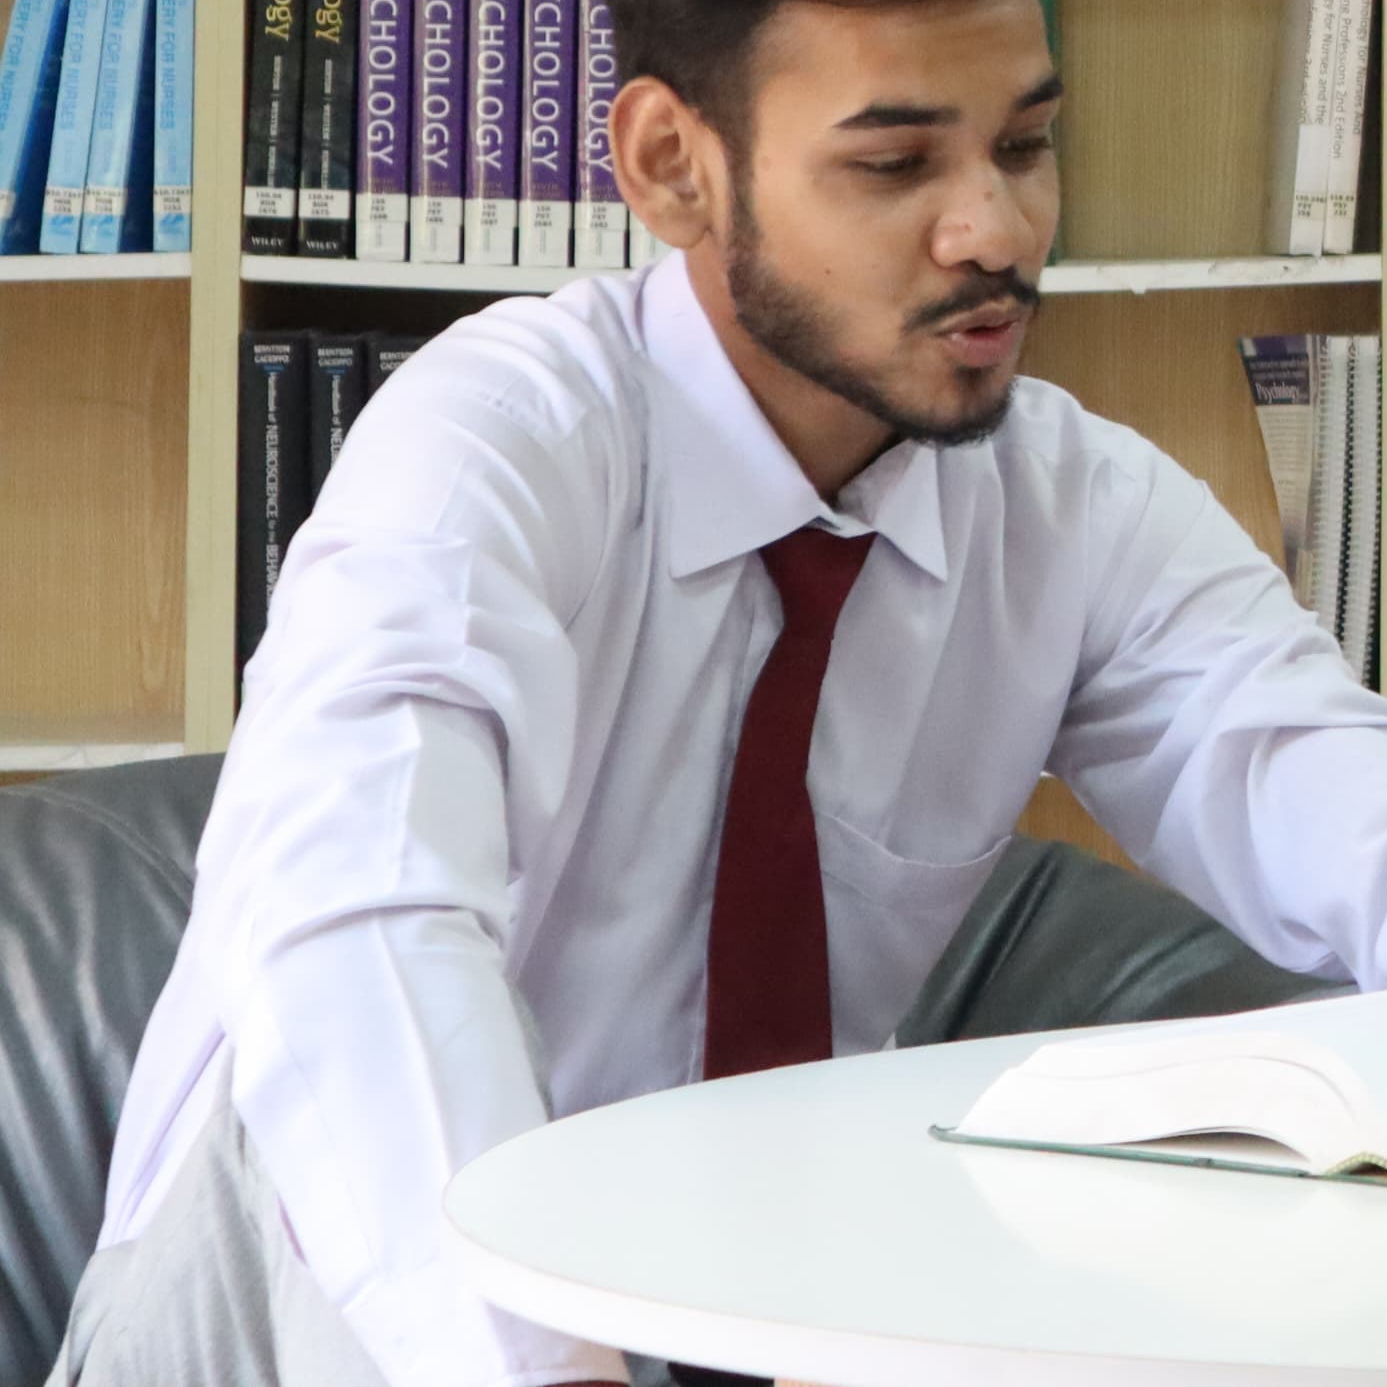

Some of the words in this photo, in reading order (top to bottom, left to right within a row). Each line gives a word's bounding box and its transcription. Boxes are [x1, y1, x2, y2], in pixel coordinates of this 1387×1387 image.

[1322, 13, 1336, 30] for
[66, 33, 79, 63] FOR
[108, 32, 121, 63] FOR
[1319, 34, 1334, 75] Nurses
[1336, 18, 1352, 86] Professions
[1356, 45, 1369, 62] for
[60, 68, 78, 130] NURSES
[100, 68, 118, 130] NURSES
[1317, 79, 1330, 101] and
[1354, 66, 1368, 108] Nurses
[1315, 105, 1328, 125] the
[1334, 91, 1348, 113] 2nd
[1351, 112, 1364, 136] And
[1331, 117, 1346, 159] Edition
[251, 235, 284, 247] WILEY
[306, 238, 339, 250] WILEY
